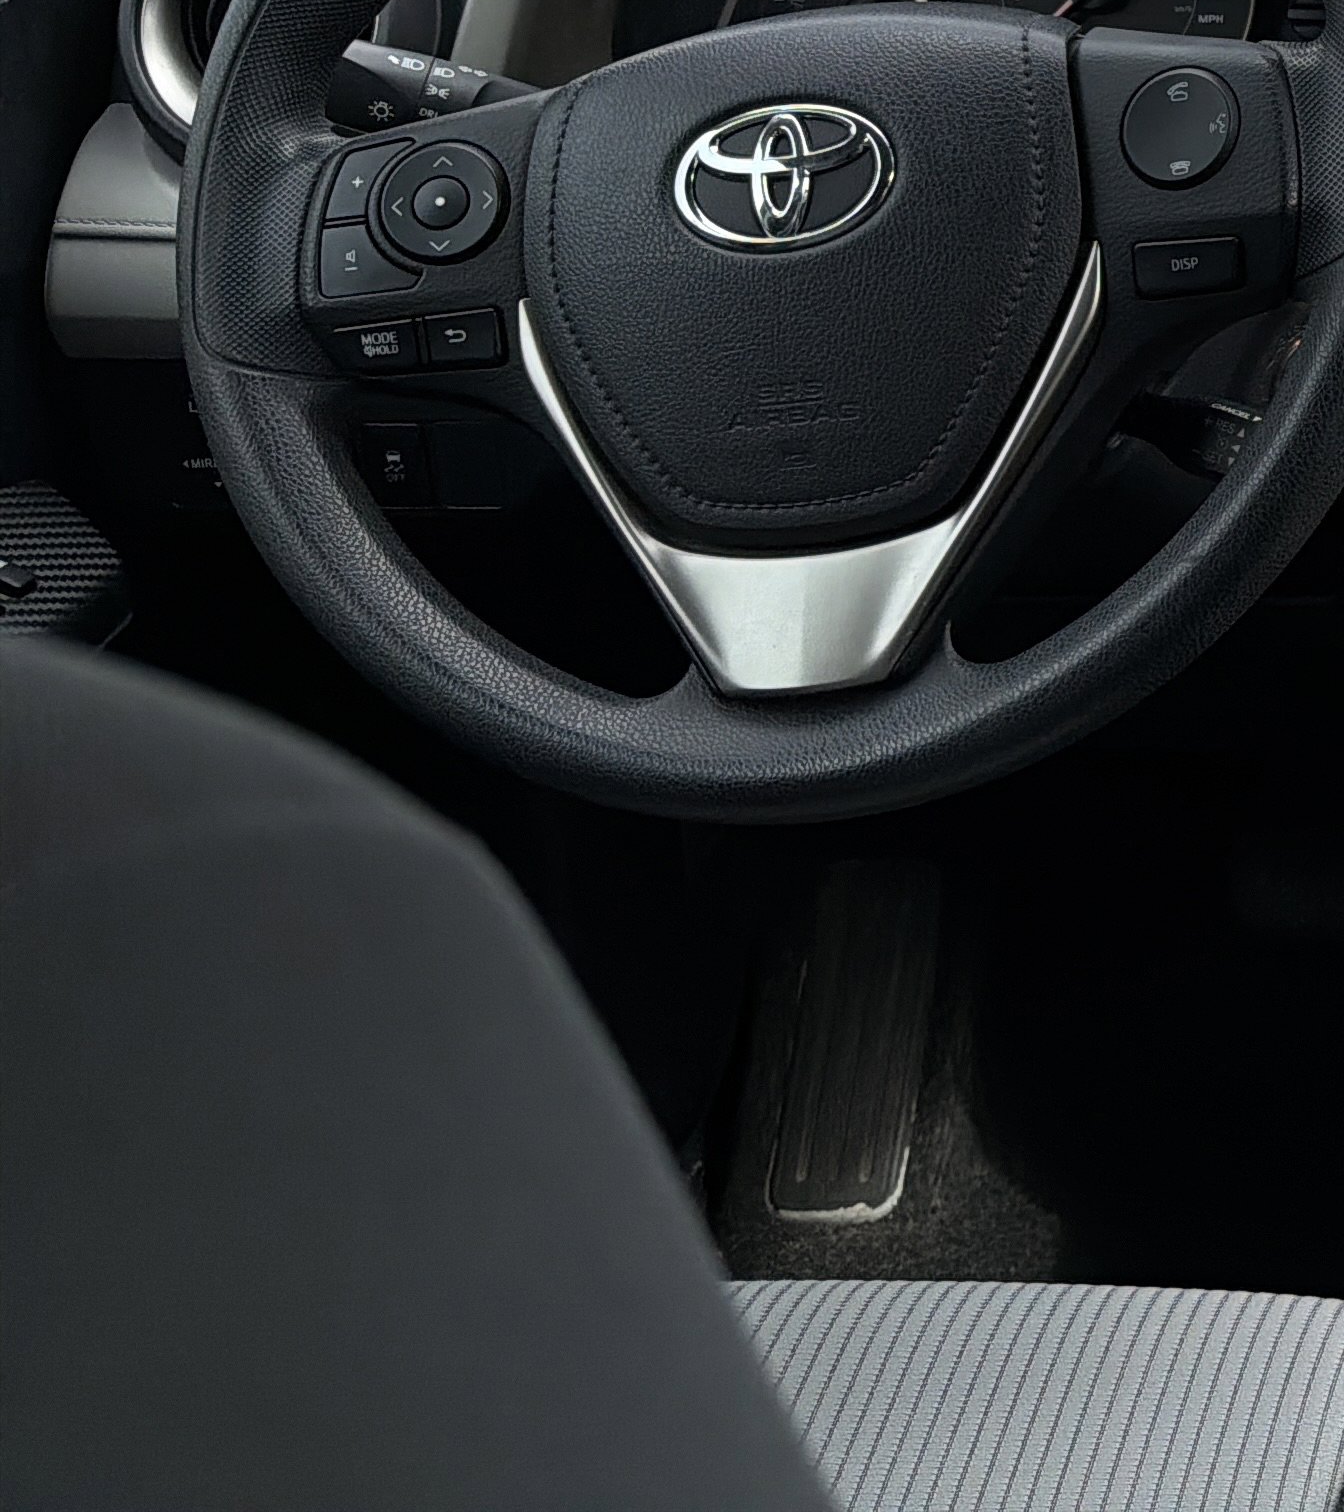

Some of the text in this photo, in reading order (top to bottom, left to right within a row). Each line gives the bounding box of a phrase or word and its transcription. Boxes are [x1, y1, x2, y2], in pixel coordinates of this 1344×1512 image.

[1197, 14, 1224, 25] MPH
[1170, 255, 1200, 273] DISP
[360, 331, 399, 346] MODE
[373, 344, 400, 356] HOLD
[1210, 403, 1251, 421] CANCEL
